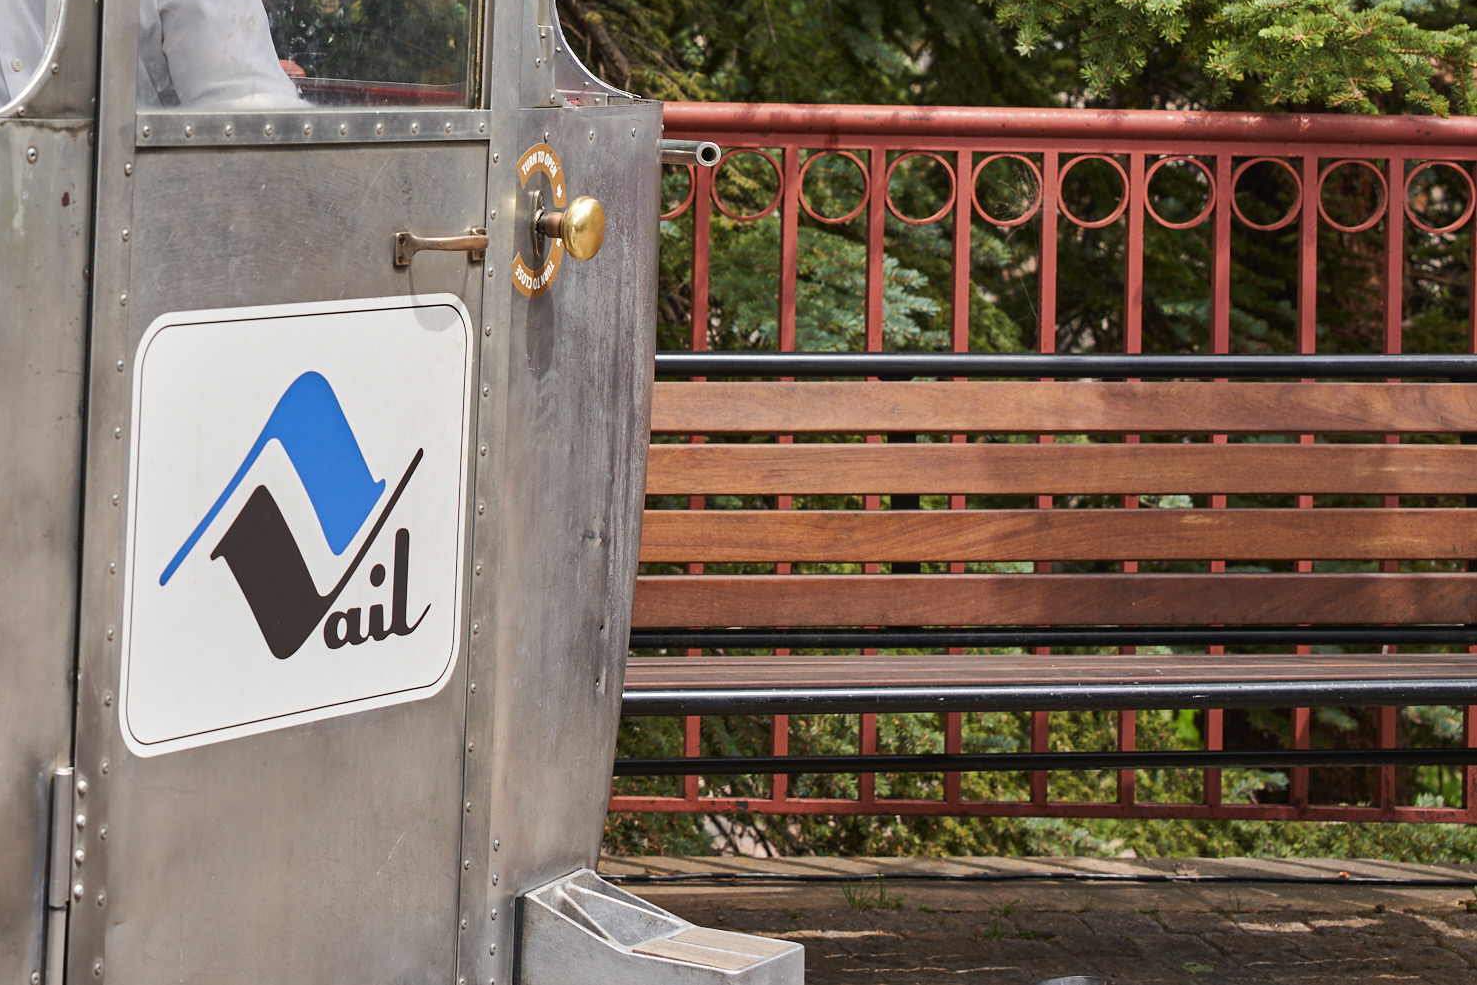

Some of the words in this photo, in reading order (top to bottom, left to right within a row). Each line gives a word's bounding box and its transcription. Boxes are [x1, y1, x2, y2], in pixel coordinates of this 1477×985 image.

[521, 152, 538, 175] TURN
[537, 151, 545, 164] TO
[544, 153, 558, 178] OPEN
[515, 264, 533, 289] CLOSE
[533, 277, 541, 290] TO
[541, 260, 555, 286] TURN
[210, 447, 431, 660] Vail
